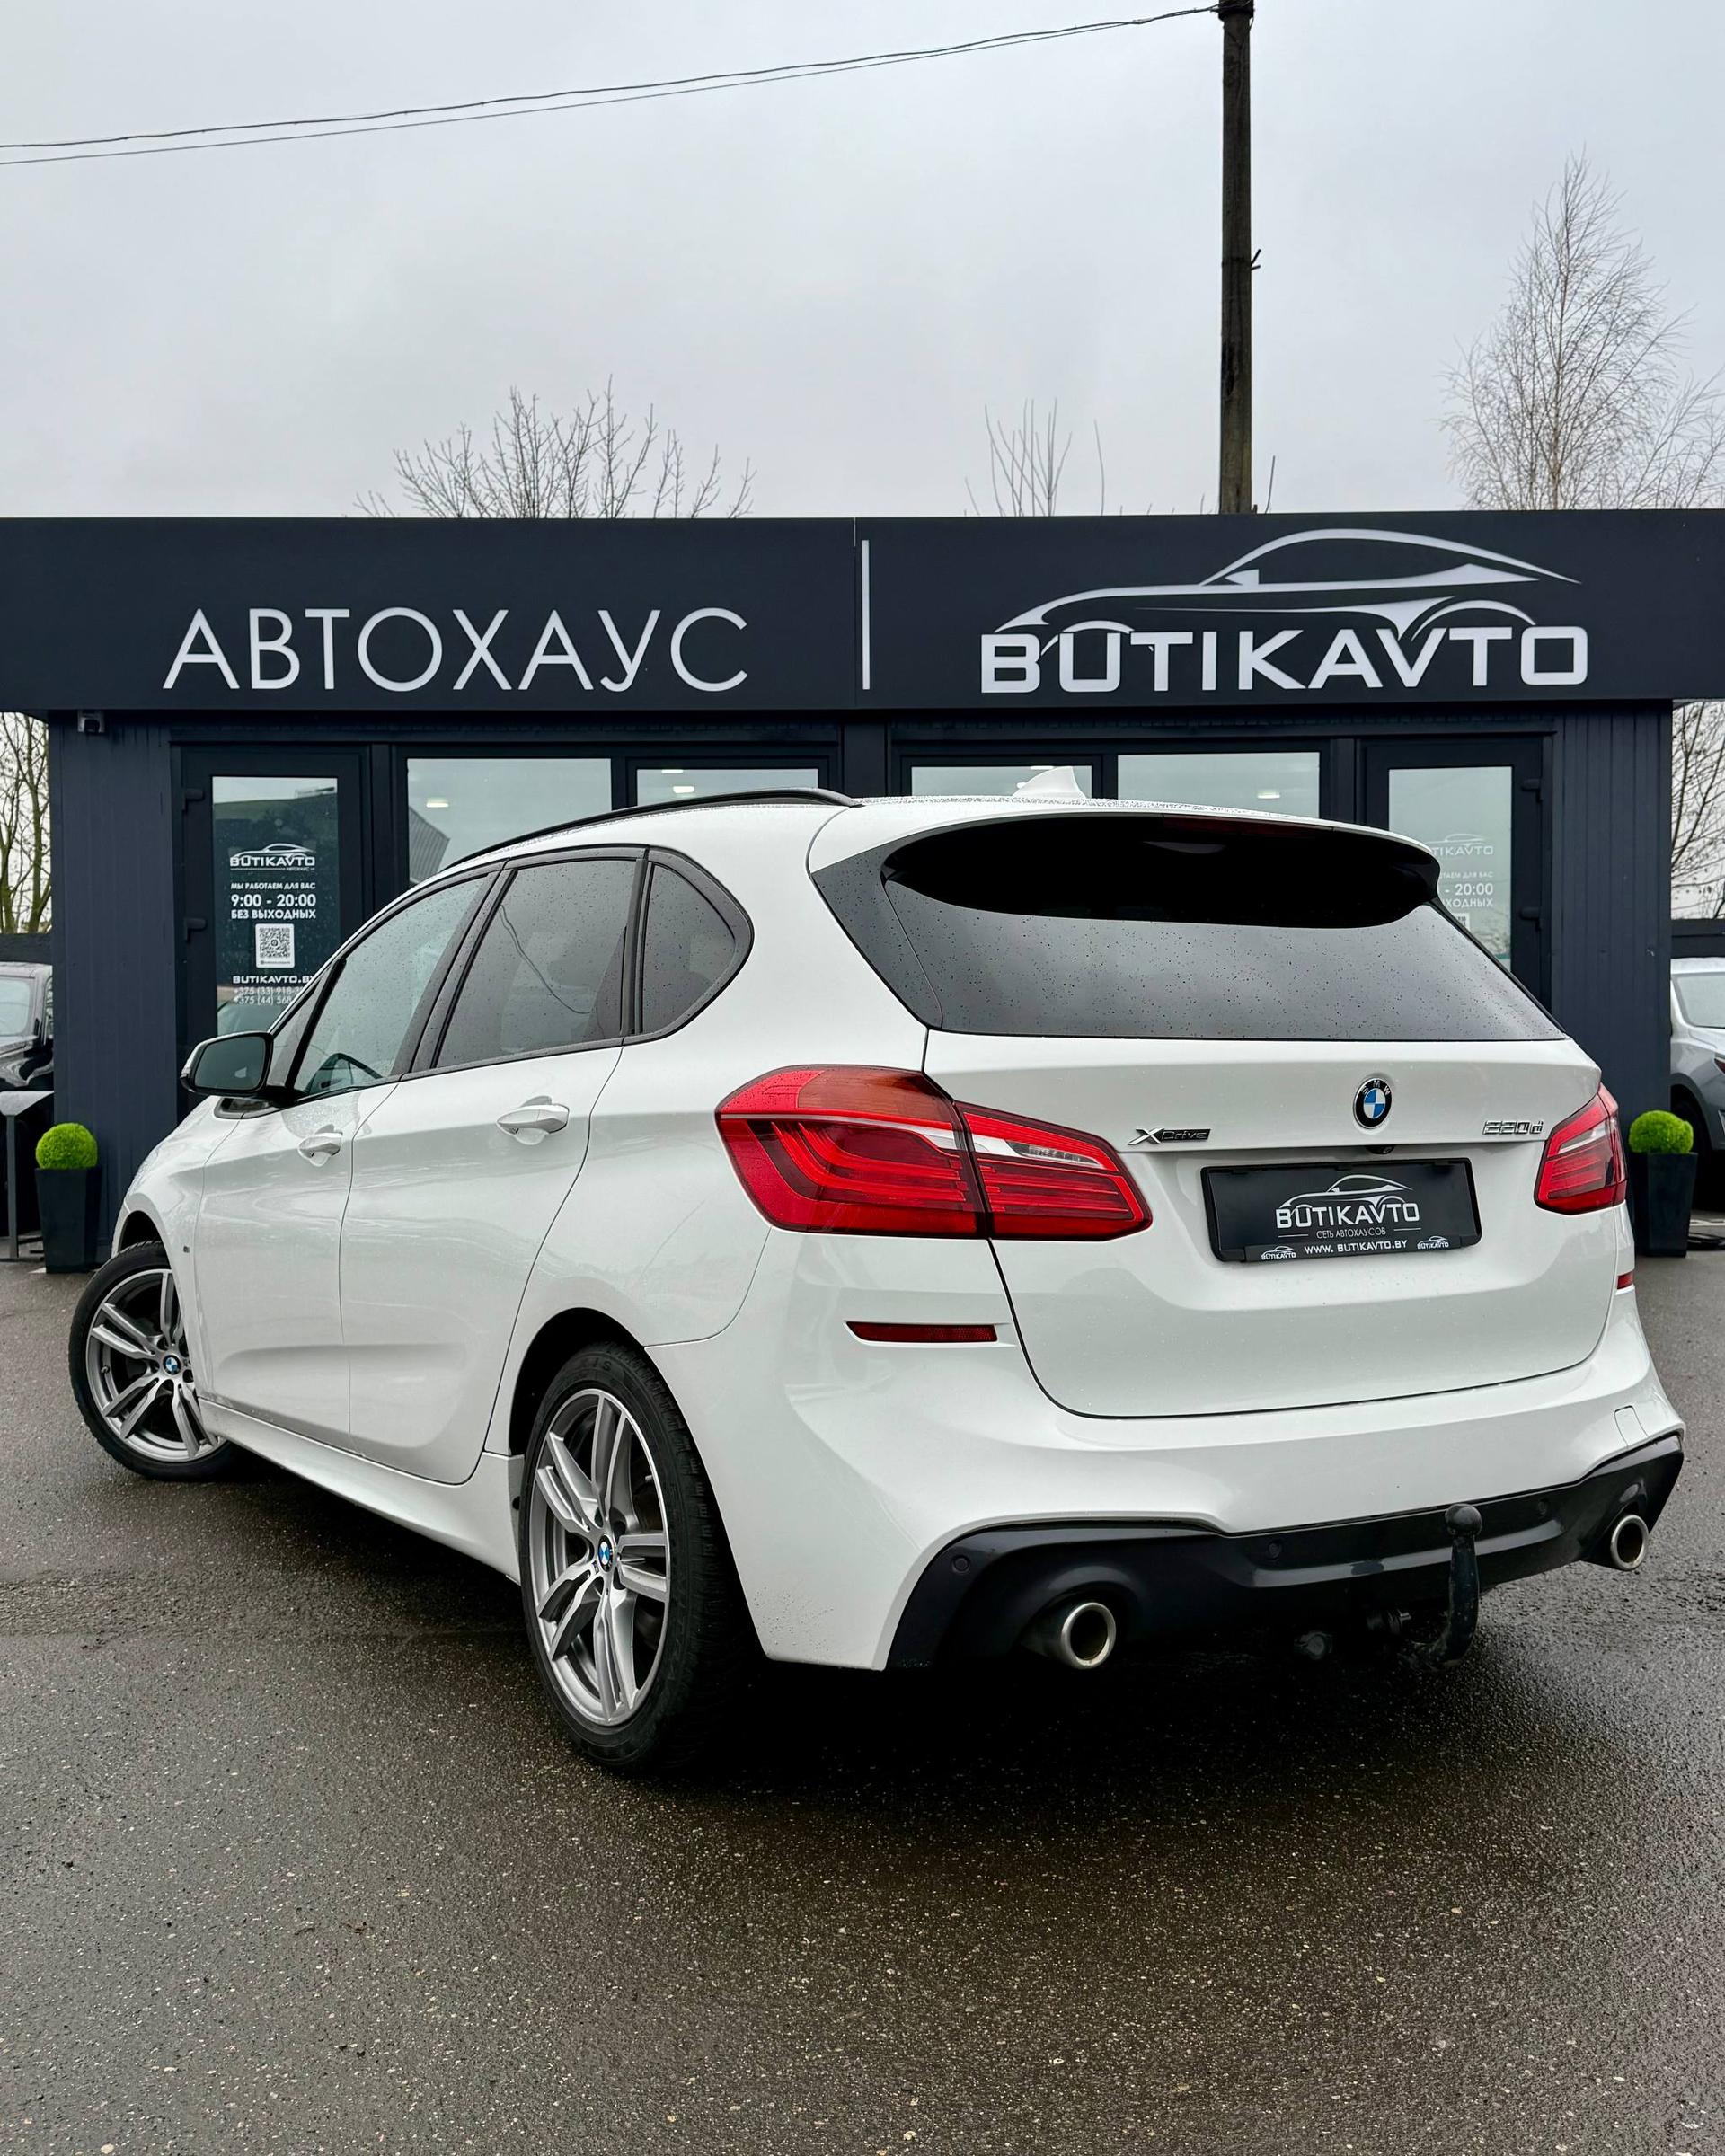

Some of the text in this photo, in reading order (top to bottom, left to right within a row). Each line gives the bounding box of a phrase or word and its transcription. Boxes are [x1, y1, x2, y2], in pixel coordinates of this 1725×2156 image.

[163, 606, 748, 692] АВТОХАУС
[980, 625, 1588, 694] BUTIKAVTO
[1432, 845, 1493, 856] TIKAVTO
[230, 856, 315, 867] BUTIKAVTO
[284, 882, 299, 890] ДЛЯ
[1455, 883, 1493, 896] 20:00
[231, 893, 262, 907] 9:00
[276, 893, 316, 907] 20:00
[1445, 898, 1493, 908] ХОДНЫХ
[231, 909, 316, 920] БЕЗ ВЫХОДНЫХ
[1482, 1121, 1544, 1135] 220d
[1276, 1203, 1420, 1228] BUTIKAVTO
[1316, 1226, 1386, 1239] СЕТЬ АВТОХАУСОВ
[1337, 1240, 1408, 1253] BUTIKAVTO.BY
[1261, 1251, 1296, 1259] BUTIKAVTO
